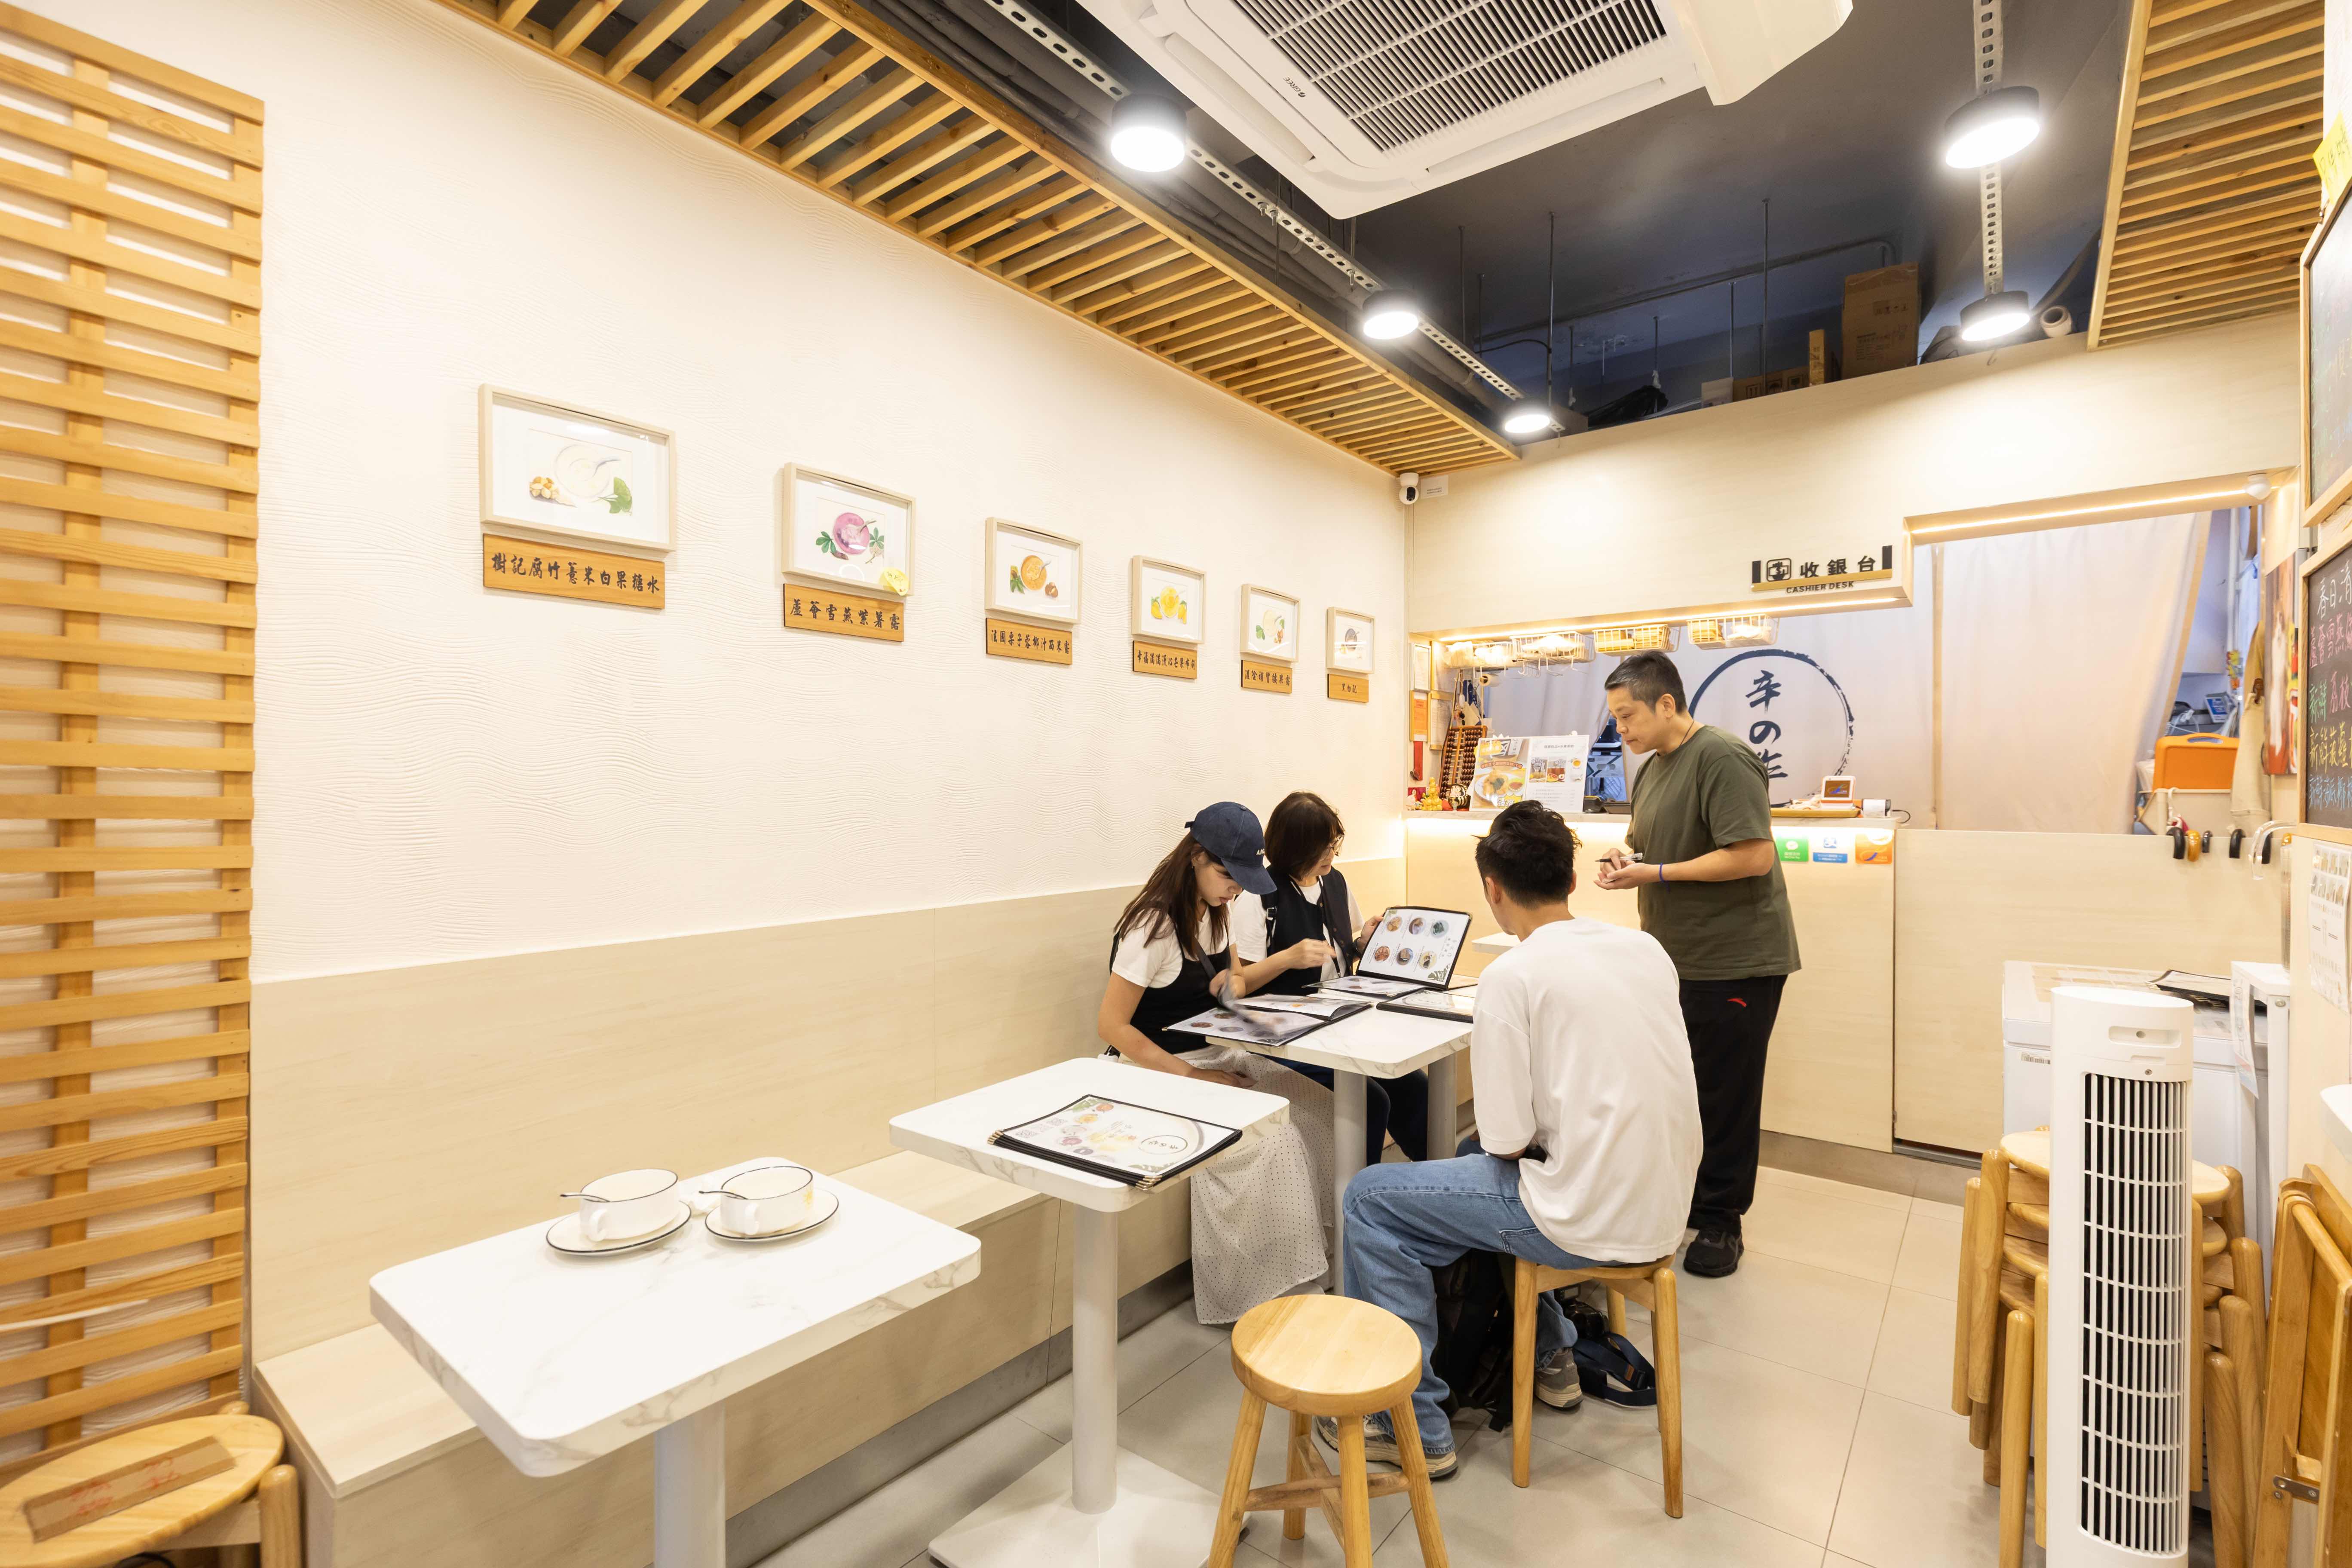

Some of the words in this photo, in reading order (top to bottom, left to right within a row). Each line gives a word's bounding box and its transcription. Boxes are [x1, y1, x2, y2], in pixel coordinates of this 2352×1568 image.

[491, 552, 660, 594] 樹記腐竹薏米白果糖水
[1800, 555, 1876, 578] 收銀台
[1786, 583, 1827, 594] CASHIER
[1829, 581, 1854, 589] DESK
[790, 598, 900, 631] 蘆薈雪燕紫薯露
